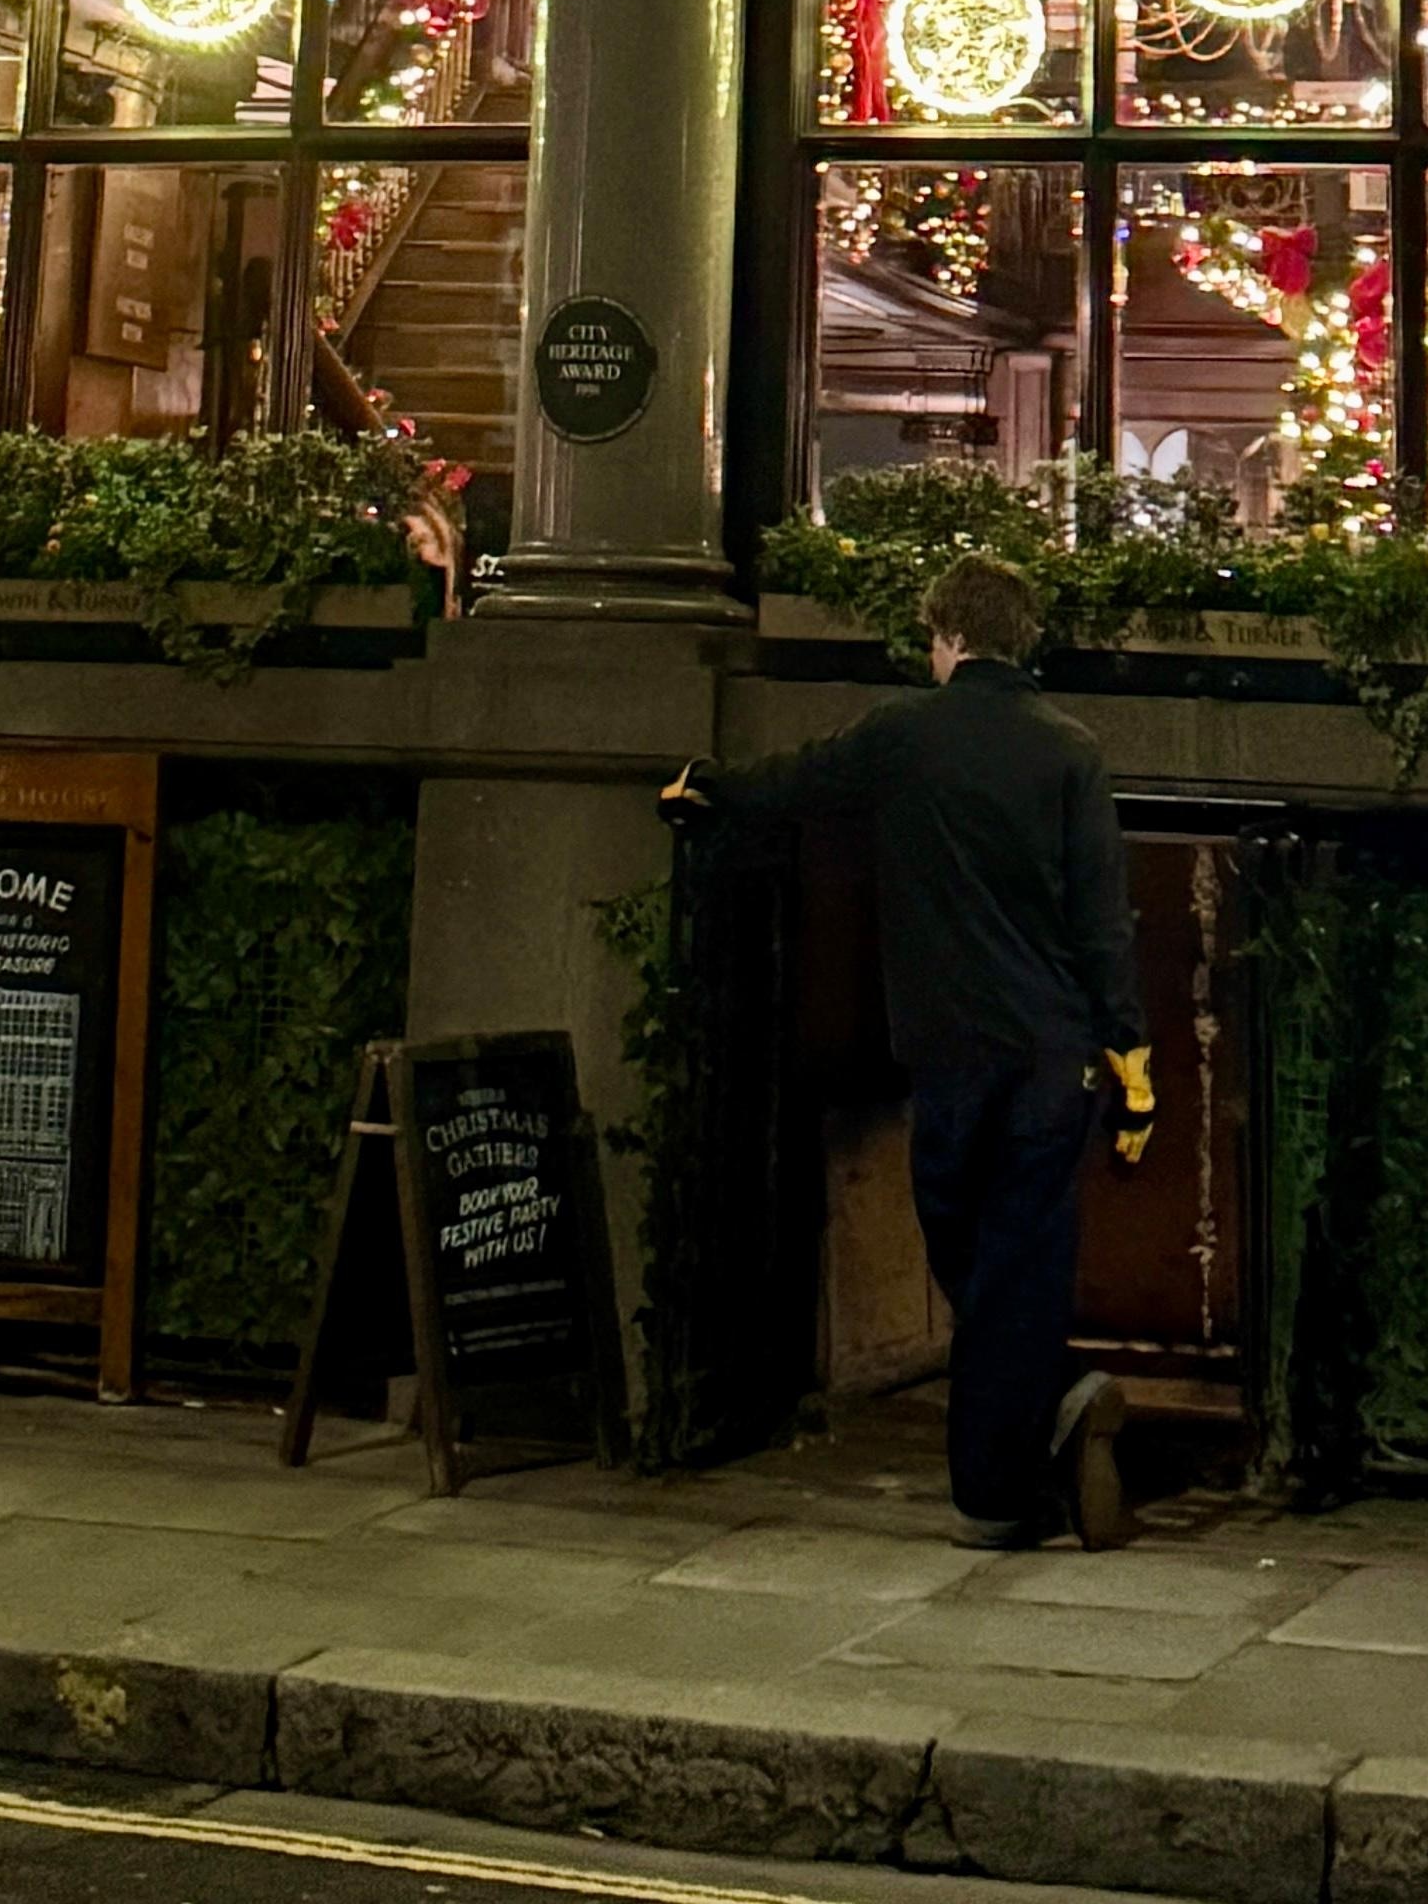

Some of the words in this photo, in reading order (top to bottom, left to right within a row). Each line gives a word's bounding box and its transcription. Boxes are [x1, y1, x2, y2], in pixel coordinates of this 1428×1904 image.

[568, 325, 610, 340] CITY
[549, 344, 632, 361] HERITAGE
[559, 364, 621, 380] AWARD
[425, 1107, 550, 1153] CHRISTMAS
[458, 1185, 502, 1217] BOOK
[439, 1210, 506, 1252] FESTIVE
[508, 1194, 562, 1230] PARTY
[463, 1233, 509, 1270] WITH
